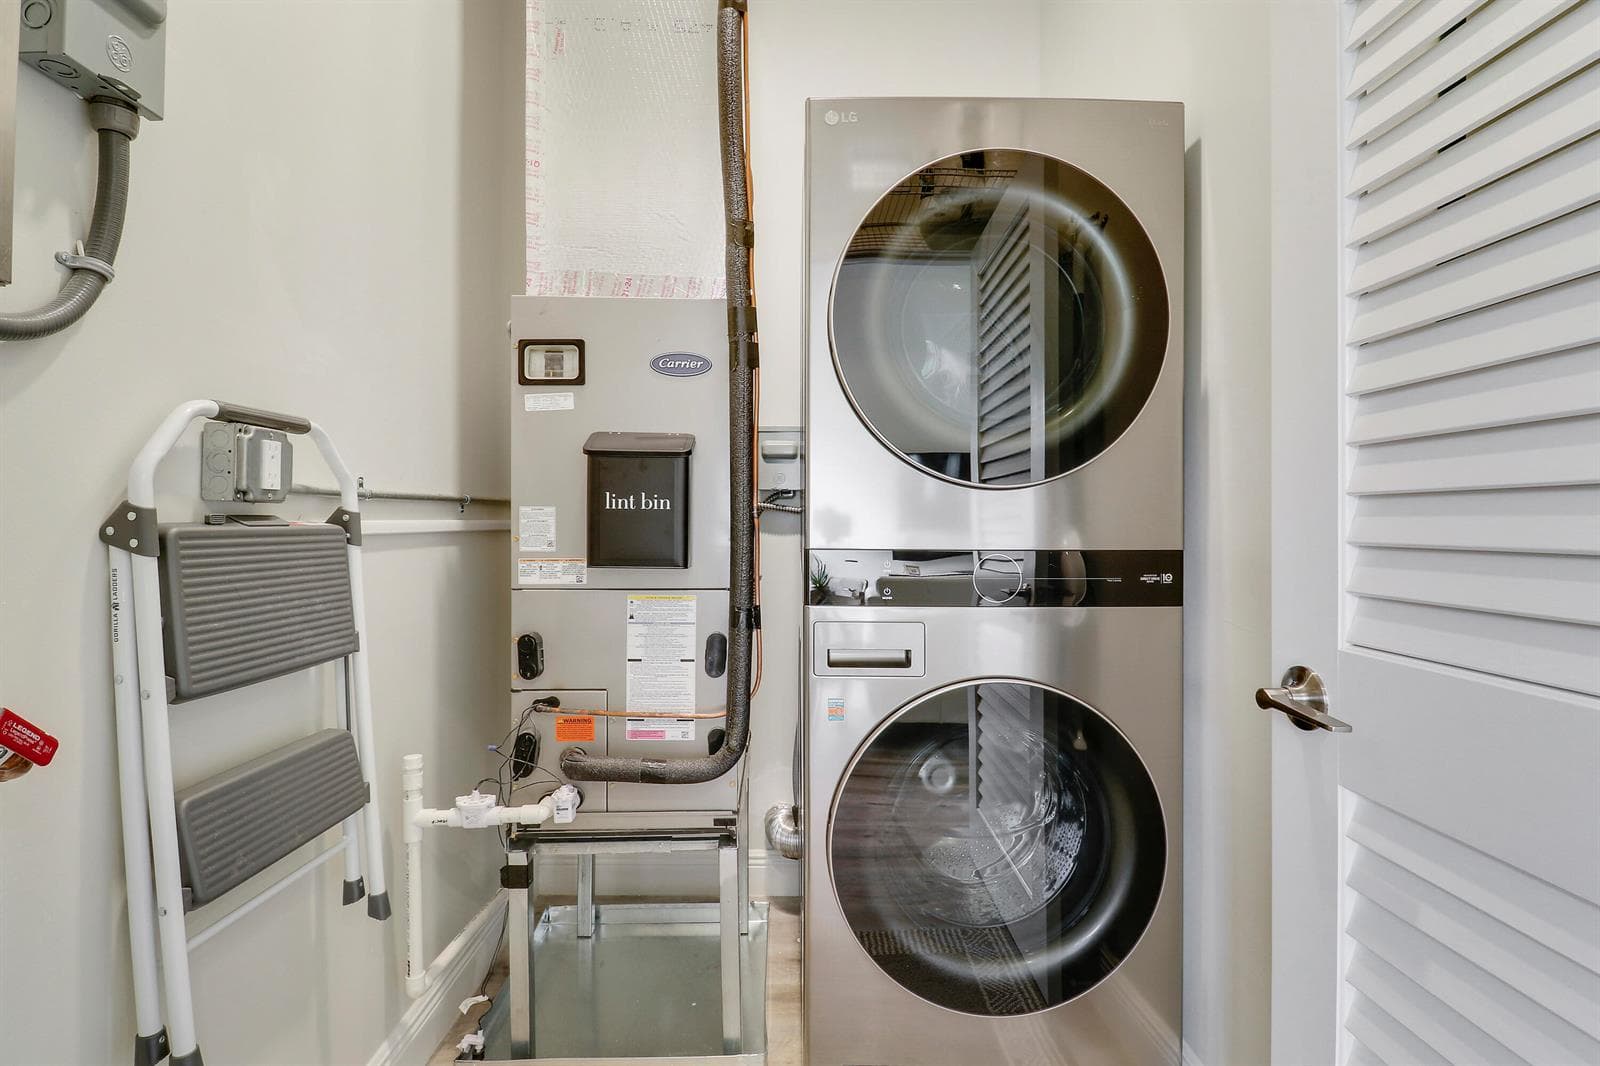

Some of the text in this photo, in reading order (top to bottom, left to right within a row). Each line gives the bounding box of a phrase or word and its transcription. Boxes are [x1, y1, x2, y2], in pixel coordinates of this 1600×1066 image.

[841, 111, 858, 122] LG
[658, 358, 704, 369] Carrier
[604, 492, 671, 510] lint bin
[12, 722, 41, 741] LEGEND
